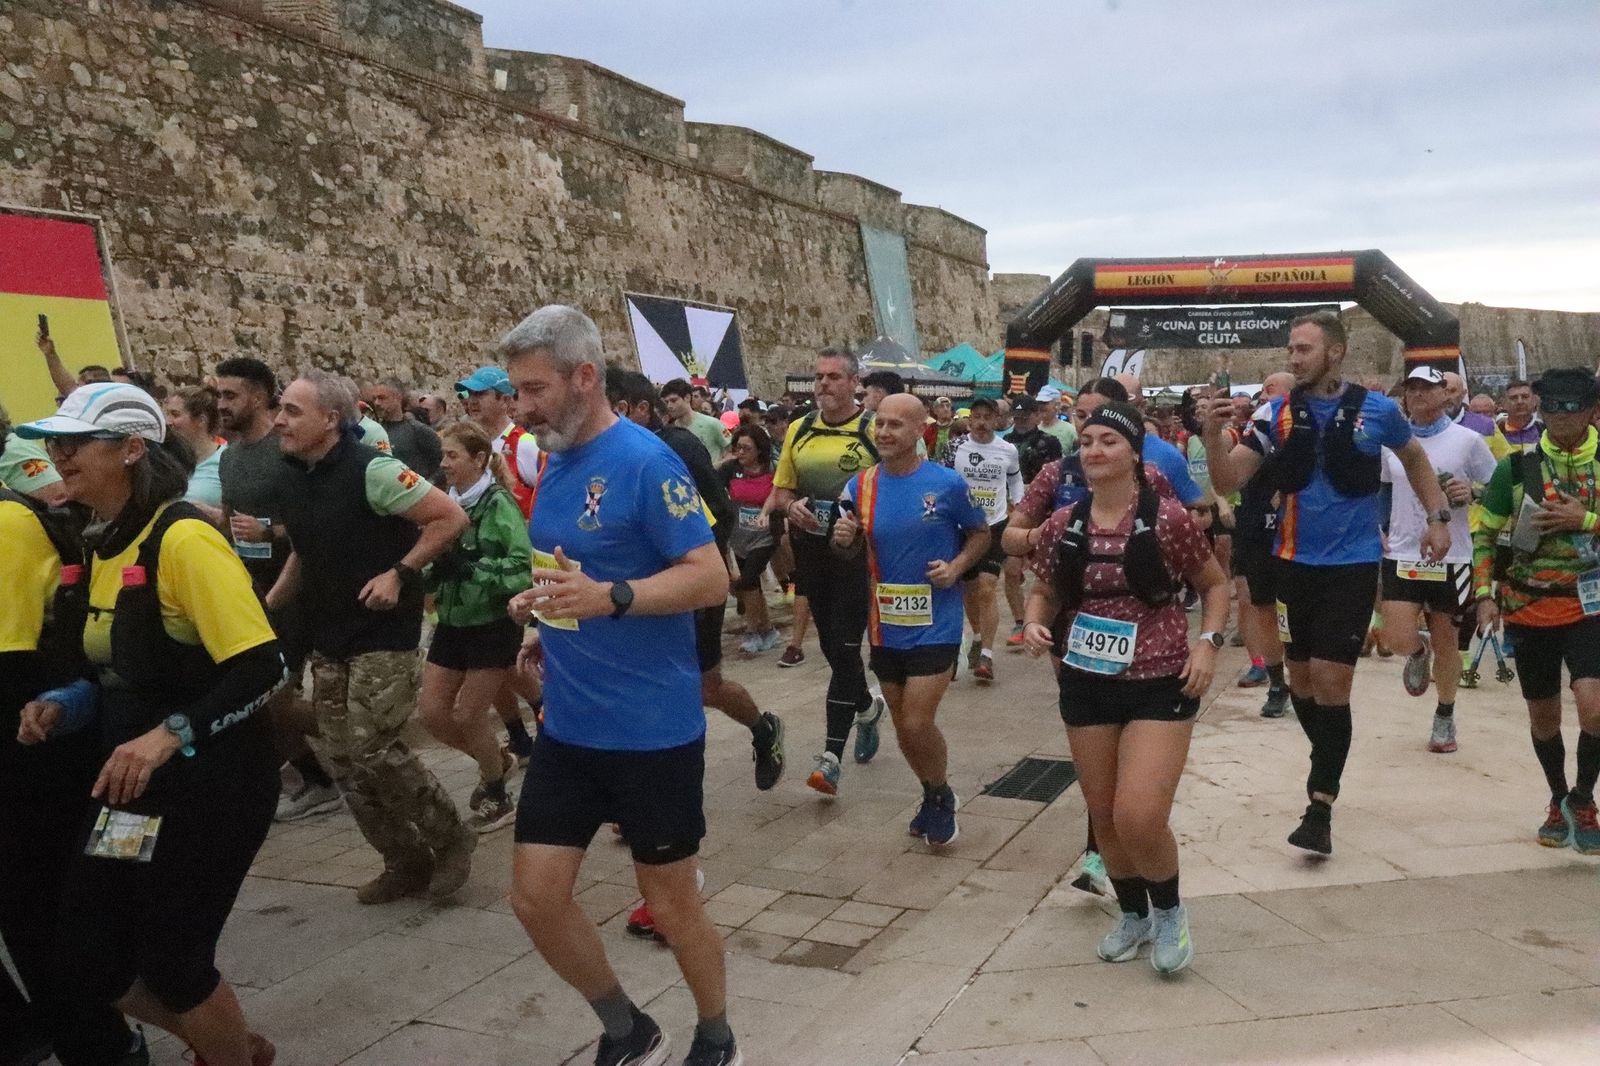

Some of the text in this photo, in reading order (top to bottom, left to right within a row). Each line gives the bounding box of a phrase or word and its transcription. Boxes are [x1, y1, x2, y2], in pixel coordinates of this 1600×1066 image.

[1127, 268, 1328, 286] LEGIÓN ESPAÑOLA
[1199, 321, 1214, 331] DE
[1217, 321, 1231, 331] LA
[1198, 333, 1241, 345] CEUTA
[1102, 409, 1139, 436] RUNNING
[964, 467, 1002, 475] BULLONES
[895, 596, 928, 610] 2132
[1085, 632, 1129, 656] 4970
